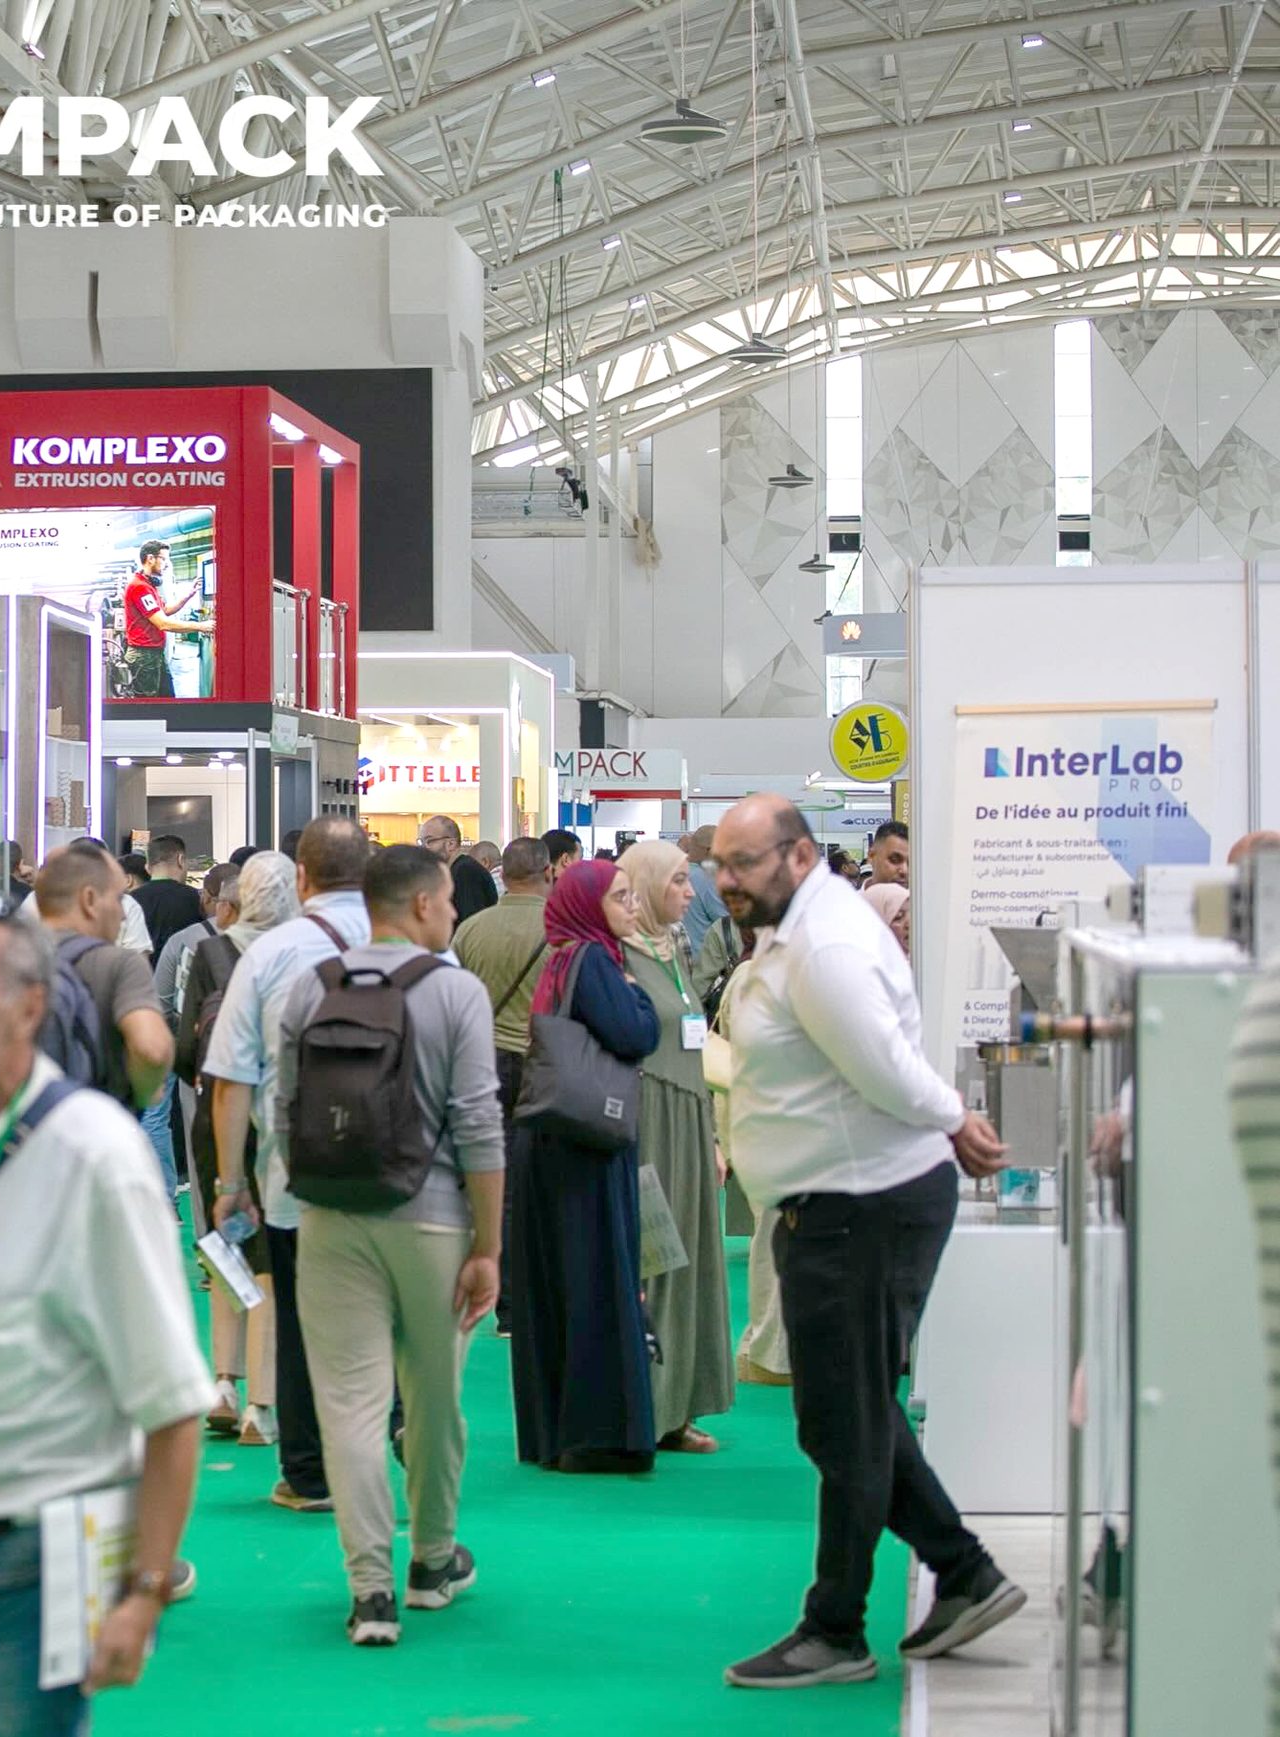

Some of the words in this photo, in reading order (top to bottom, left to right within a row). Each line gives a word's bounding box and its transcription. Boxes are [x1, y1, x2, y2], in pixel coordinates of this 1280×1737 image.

[13, 434, 226, 465] KOMPLEXO
[14, 472, 127, 488] EXTRUSION
[132, 471, 226, 487] COATING
[1015, 743, 1183, 777] InterLab
[1109, 778, 1183, 792] PROD
[975, 805, 999, 820] De
[1004, 803, 1051, 819] l'idée
[1056, 807, 1079, 819] au
[1083, 802, 1151, 822] produit
[1156, 801, 1188, 818] fini
[973, 838, 1022, 849] Fabricant
[1025, 838, 1033, 849] &
[1036, 838, 1104, 849] sous-traitant
[1106, 840, 1122, 848] en
[973, 853, 1034, 862] Manufacturer
[1045, 852, 1109, 862] subcontractor
[972, 1016, 1004, 1025] Dietary
